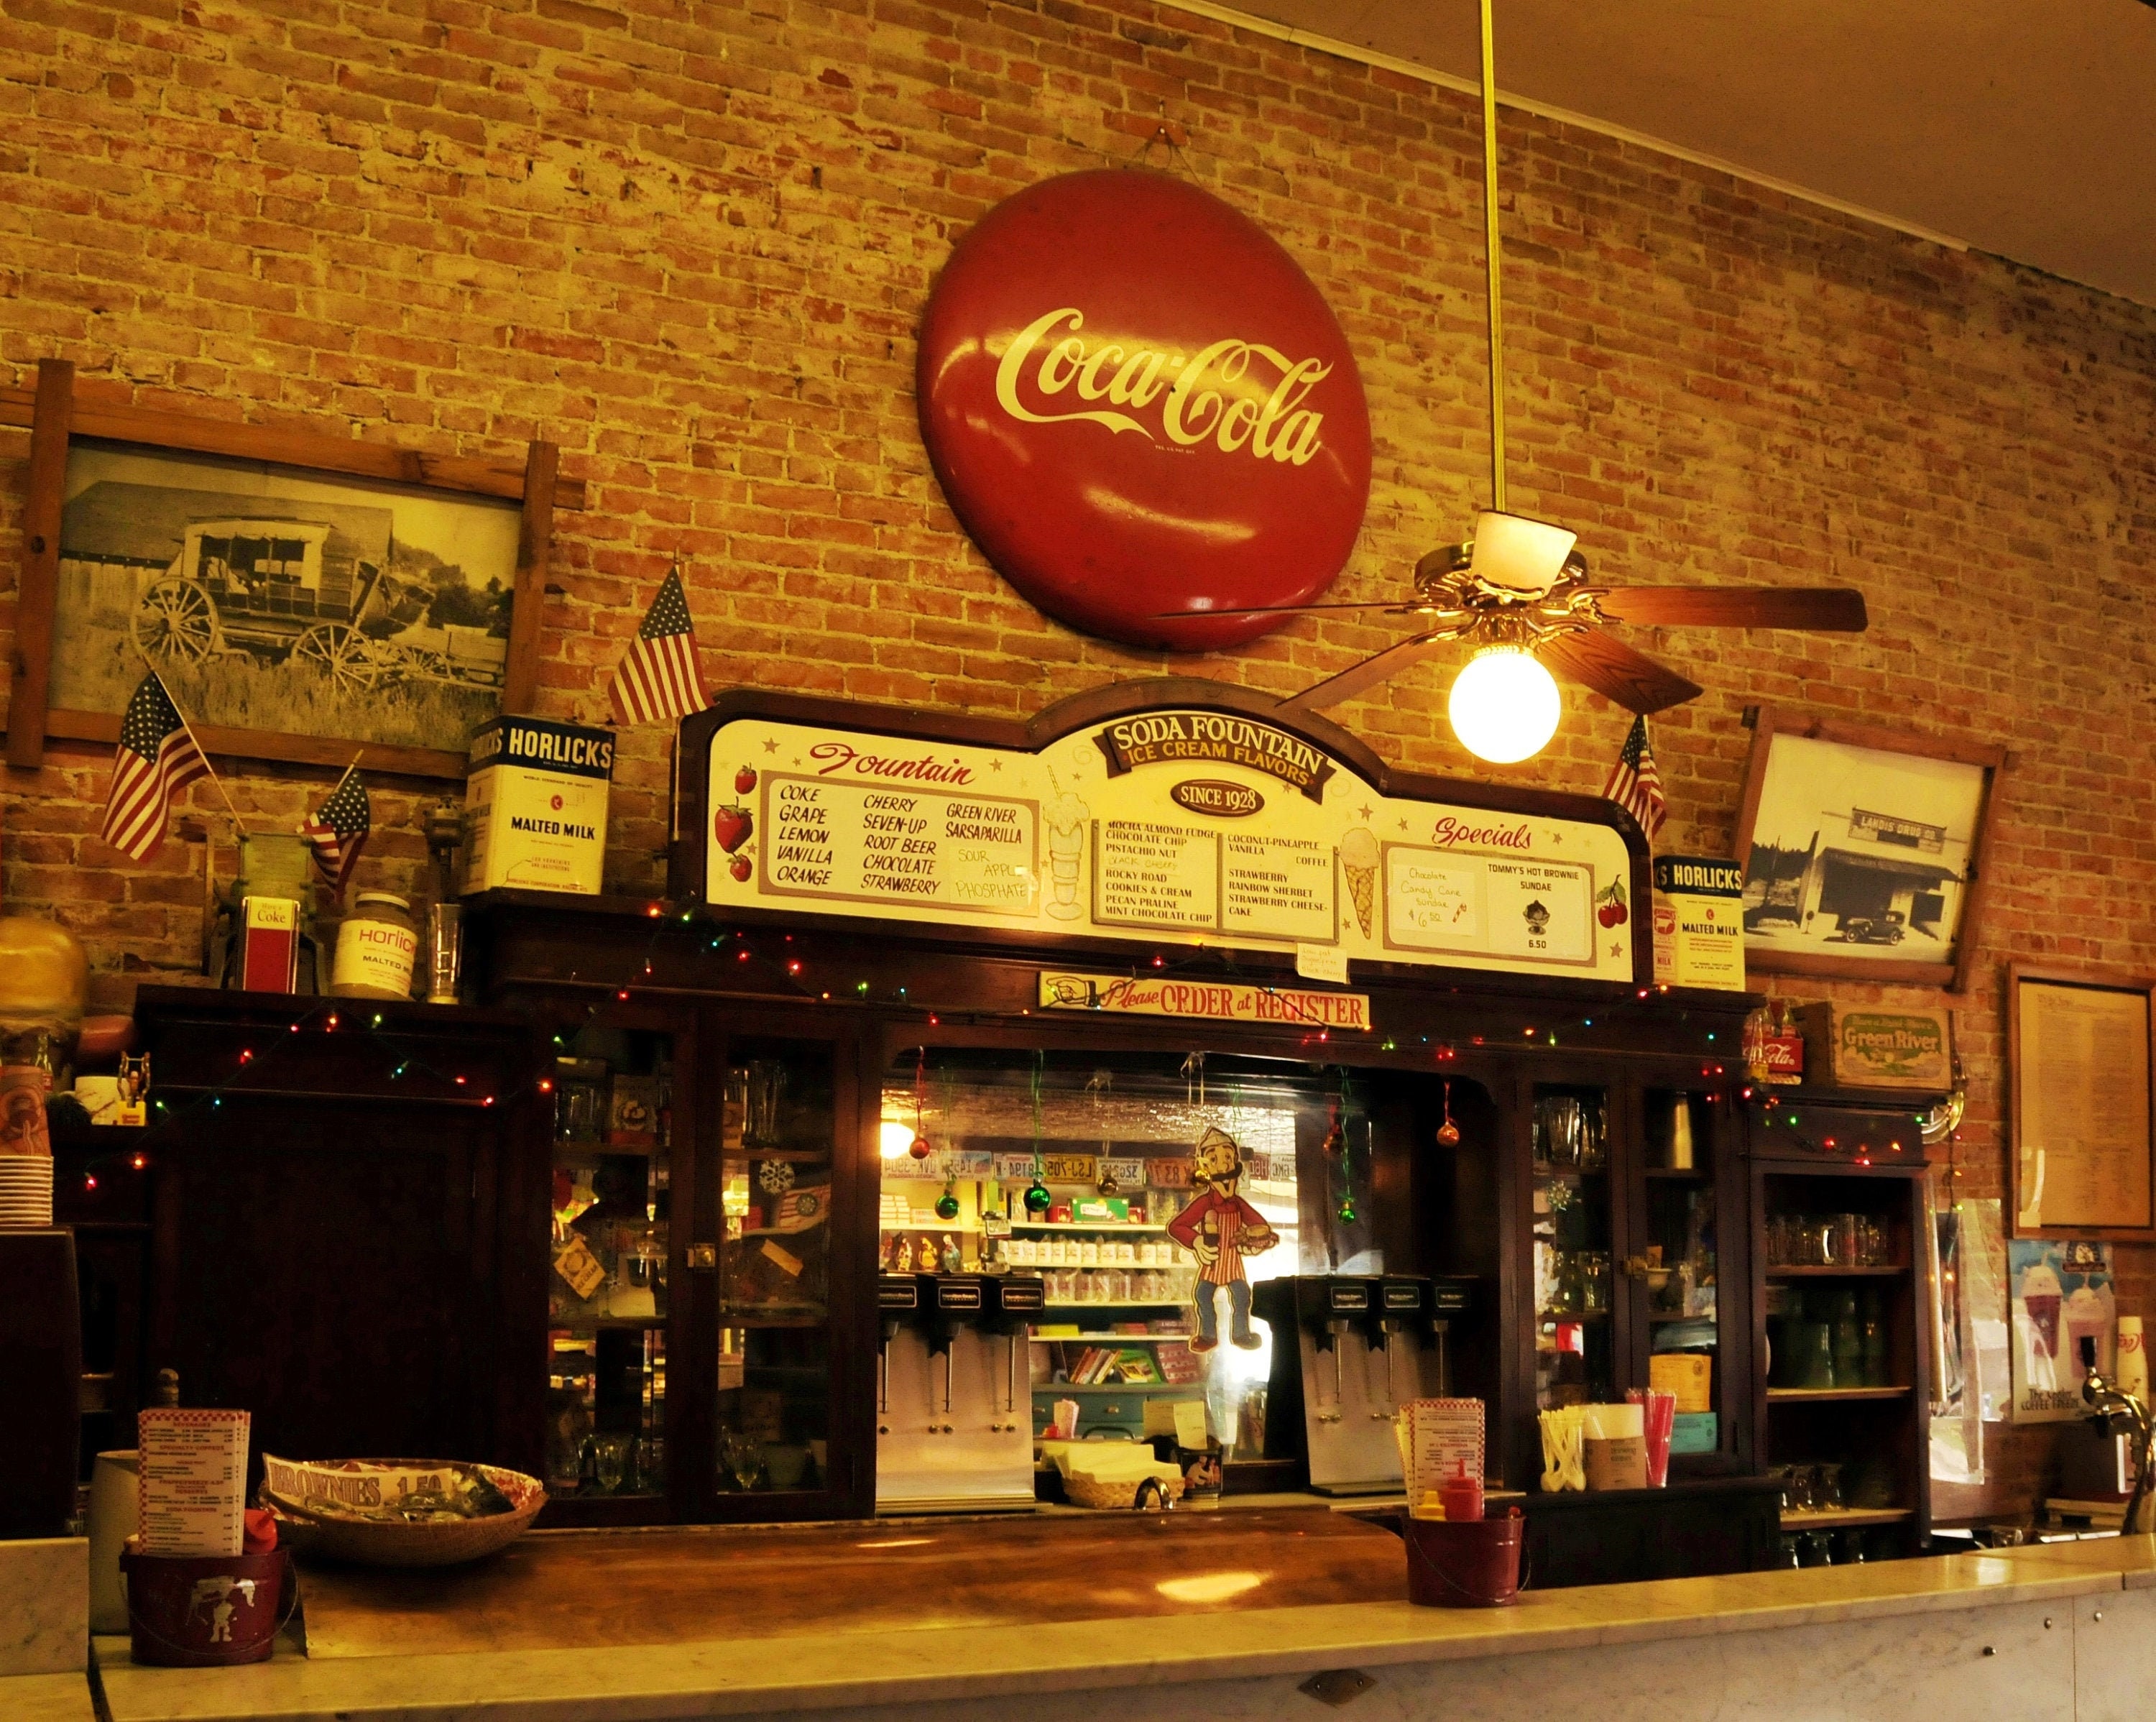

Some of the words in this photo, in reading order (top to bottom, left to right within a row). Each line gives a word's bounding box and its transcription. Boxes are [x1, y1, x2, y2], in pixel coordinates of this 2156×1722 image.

[996, 307, 1334, 466] Coca-Cola
[509, 727, 612, 769] HORLICKS
[1113, 717, 1187, 750] SODA
[1191, 716, 1324, 775] FOUNTAIN
[808, 742, 977, 786] Fountain
[1128, 743, 1157, 764] ICE
[1162, 742, 1227, 758] CREAM
[1234, 746, 1309, 786] FLAVORS
[780, 784, 821, 803] COKE
[1181, 786, 1222, 806] SINCE
[1225, 789, 1256, 809] 1928
[863, 794, 918, 813] CHERRY
[779, 805, 828, 825] GRAPE
[946, 803, 984, 820] GREEN
[983, 806, 1018, 824] RIVER
[511, 816, 560, 835] MALTED
[563, 824, 595, 840] MILK
[863, 814, 928, 834] SEVEN-UP
[945, 821, 1022, 845] SARSAPARILLA
[1108, 821, 1141, 831] MOCHA
[1145, 824, 1182, 835] ALMOND
[1186, 828, 1215, 839] FUDGE
[1432, 816, 1531, 850] Specials
[779, 827, 831, 844] LEMON
[864, 834, 900, 852] ROOT
[901, 837, 936, 856] BEER
[1106, 830, 1162, 844] CHOCOLATE
[1165, 837, 1187, 846] CHIP
[1228, 834, 1319, 850] COCONUT-PINEAPPLE
[777, 845, 833, 865] VANILLA
[959, 849, 990, 862] SOUR
[1106, 844, 1156, 856] PISTACHIO
[1159, 849, 1176, 858] NUT
[1229, 844, 1265, 855] VANILLA
[863, 854, 936, 876] CHOCOLATE
[1296, 856, 1328, 867] COFFEE
[777, 865, 832, 886] ORANGE
[1106, 870, 1138, 879] ROCKY
[1141, 873, 1167, 883] ROAD
[1229, 869, 1288, 883] STRAWBERRY
[1409, 867, 1447, 880] Chocolate
[1488, 863, 1524, 875] TOMMY'S
[1526, 866, 1542, 876] HOT
[1544, 867, 1580, 880] BROWNIE
[1673, 865, 1742, 890] HORLICKS
[860, 873, 941, 896] STRAWBERRY
[956, 880, 1027, 899] PHOSPHATE
[1106, 883, 1147, 893] COOKIES
[1161, 888, 1192, 897] CREAM
[1229, 881, 1271, 893] RAINBOW
[1273, 886, 1312, 898] SHERBET
[1401, 880, 1432, 899] Candy
[1438, 885, 1461, 896] Cane
[1520, 881, 1552, 892] SUNDAE
[1106, 895, 1136, 905] PECAN
[1140, 899, 1179, 909] PRALINE
[1229, 894, 1288, 907] STRAWBERRY
[1291, 901, 1327, 911] CHEESE-
[1229, 906, 1253, 916] CAKE
[257, 911, 286, 924] Coke
[1106, 906, 1128, 915] MINT
[1132, 908, 1187, 921] CHOCOLATE
[1190, 913, 1212, 922] CHIP
[1682, 923, 1714, 934] MALTED
[1717, 926, 1738, 936] MILK
[1528, 939, 1547, 949] 6.50
[363, 955, 402, 970] MALTED
[1100, 980, 1158, 1008] Please
[1160, 985, 1233, 1017] ORDER
[1237, 998, 1252, 1010] at
[1255, 990, 1363, 1024] REGISTER
[270, 1463, 382, 1507] BROWNIES
